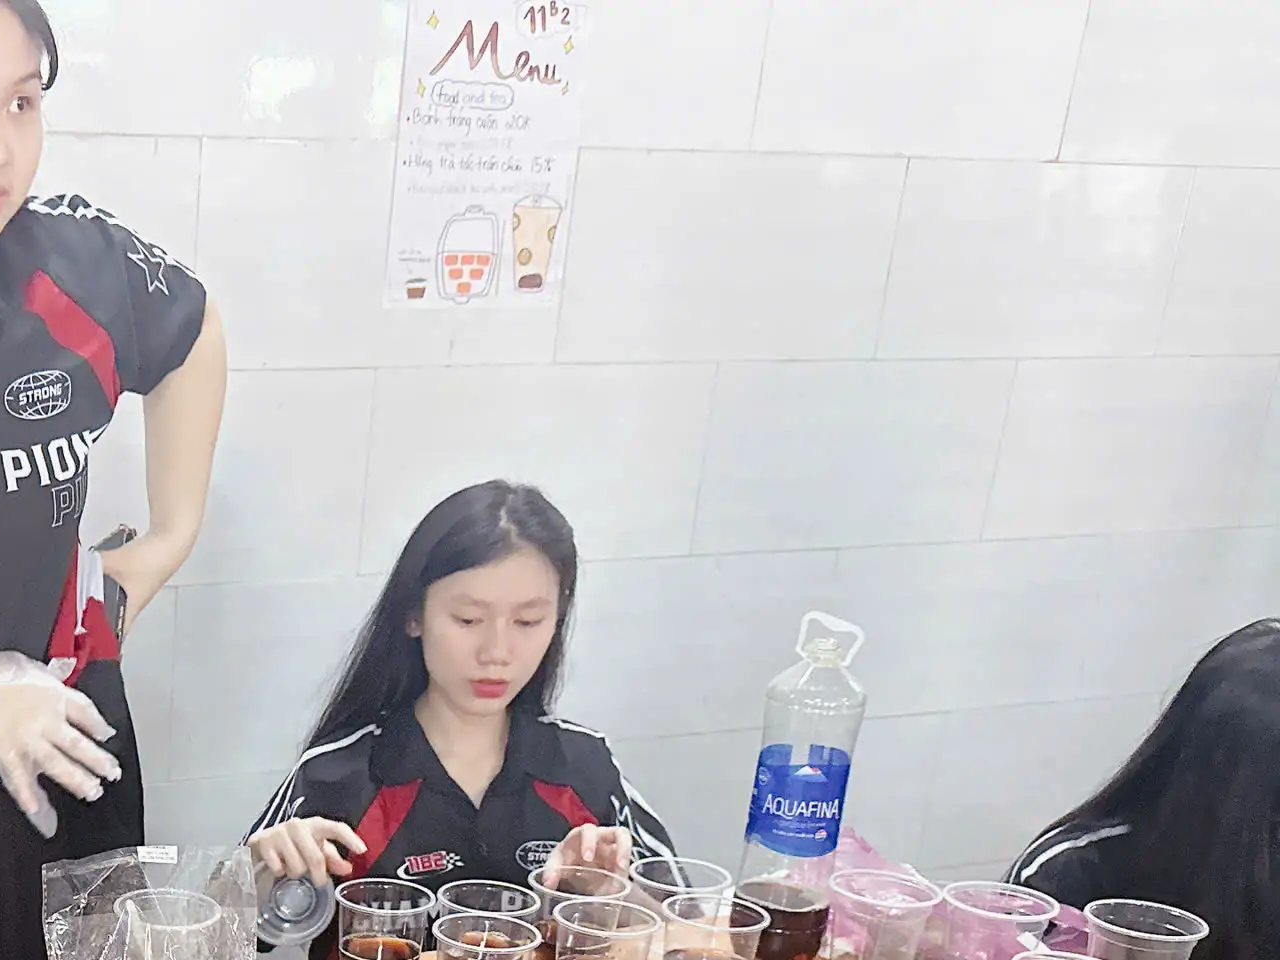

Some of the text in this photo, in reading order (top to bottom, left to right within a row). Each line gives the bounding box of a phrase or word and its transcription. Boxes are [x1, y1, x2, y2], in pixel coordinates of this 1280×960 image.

[429, 19, 562, 84] Menu
[18, 383, 63, 406] STRONG
[761, 793, 840, 820] AQUAFINA
